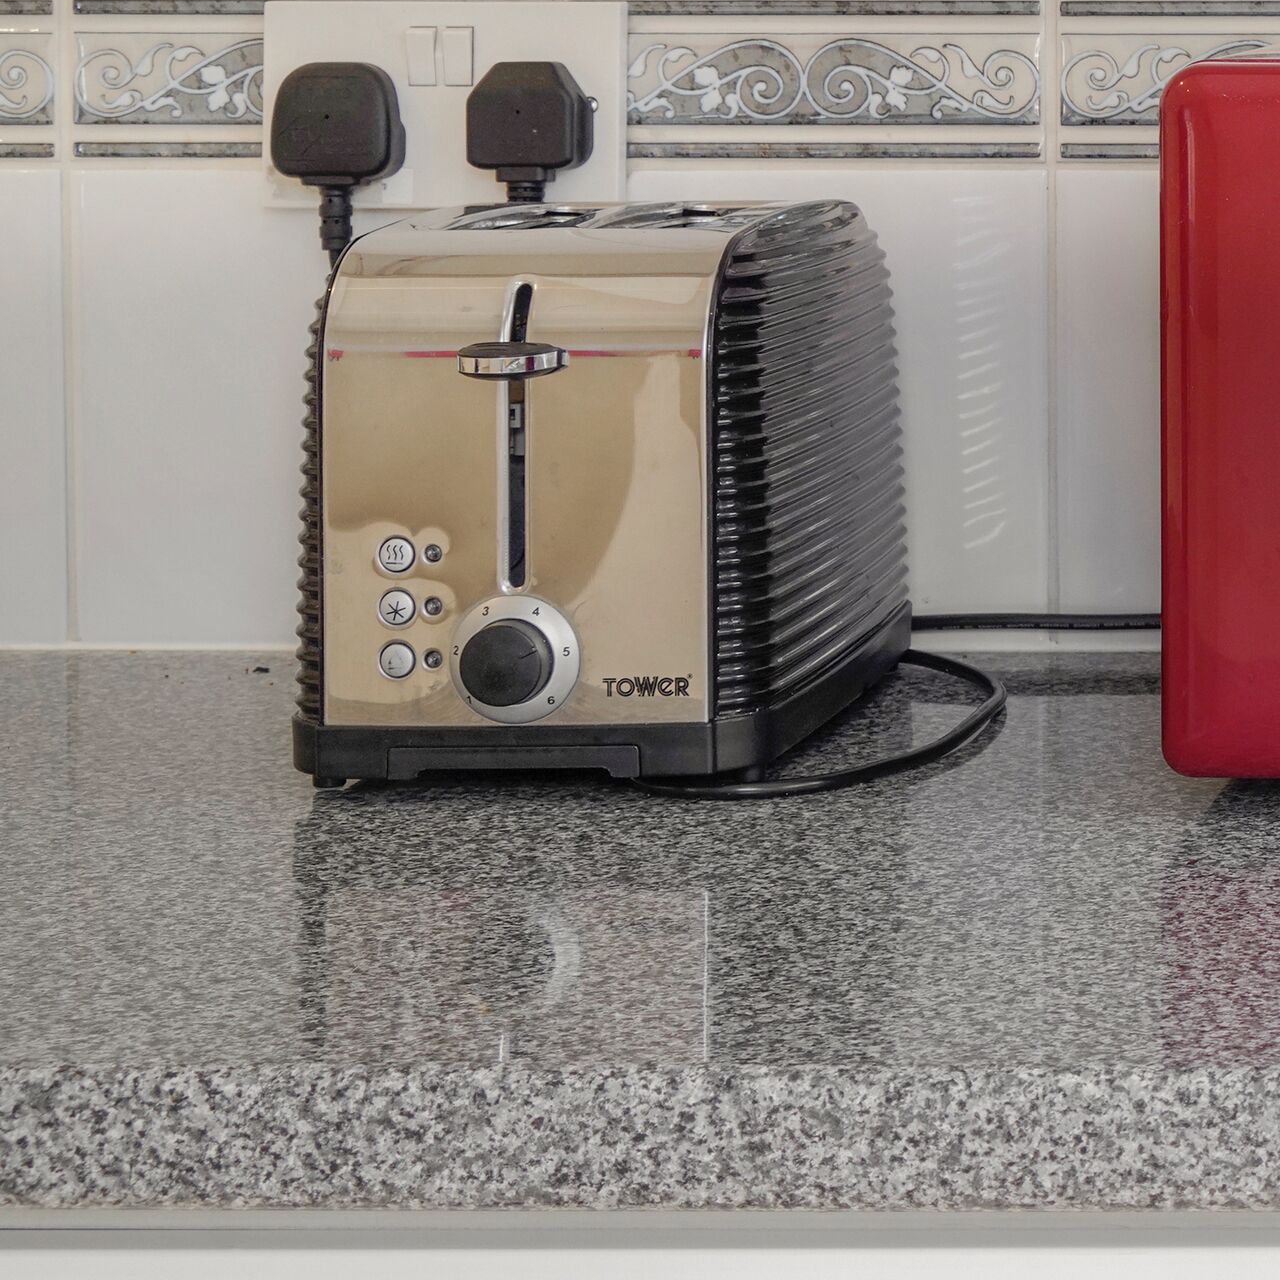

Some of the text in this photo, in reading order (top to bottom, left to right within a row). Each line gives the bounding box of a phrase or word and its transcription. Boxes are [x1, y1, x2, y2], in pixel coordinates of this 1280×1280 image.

[482, 606, 490, 616] 3
[532, 607, 541, 617] 4
[453, 646, 459, 656] 2
[563, 647, 570, 656] 5
[466, 695, 472, 705] 1
[547, 696, 555, 705] 6
